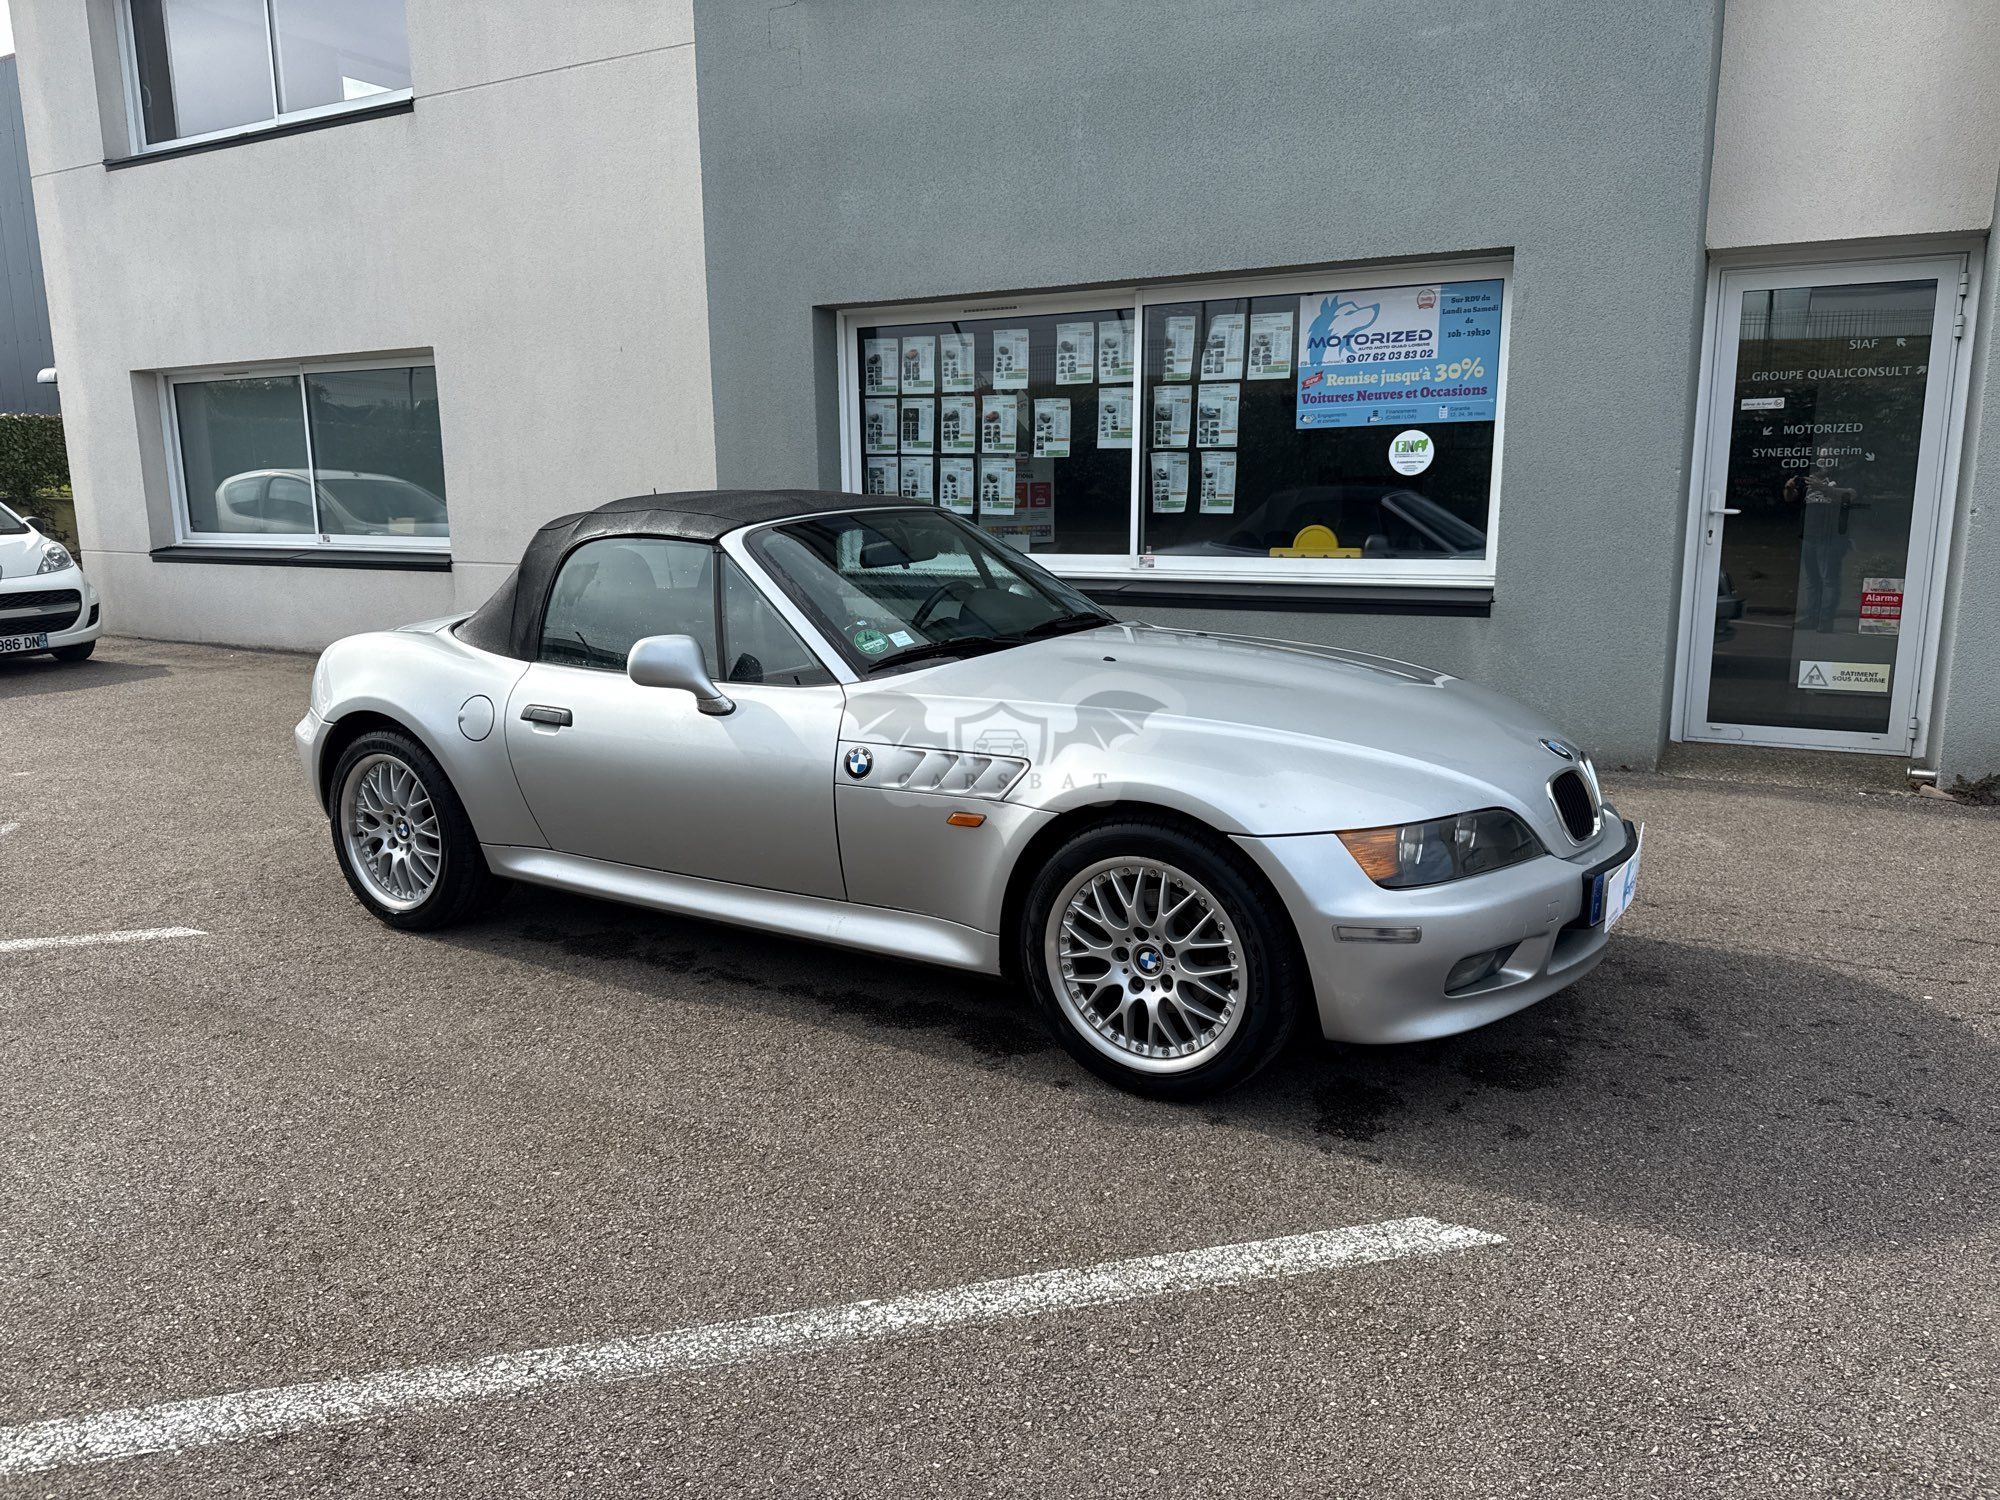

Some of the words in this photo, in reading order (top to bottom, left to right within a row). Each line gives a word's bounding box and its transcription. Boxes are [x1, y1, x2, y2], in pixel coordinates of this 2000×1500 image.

[1451, 296, 1463, 304] Sur
[1464, 295, 1480, 303] RDV
[1481, 294, 1491, 302] du
[1442, 305, 1462, 314] Lundi
[1472, 304, 1499, 313] Samedi
[1307, 329, 1433, 349] MOTORIZED
[1448, 329, 1462, 338] 10h
[1467, 328, 1491, 337] 19h30
[1849, 338, 1879, 350] SIAF
[1358, 354, 1371, 362] 07
[1373, 352, 1386, 361] 62
[1388, 352, 1402, 360] 03
[1404, 350, 1417, 359] 83
[1420, 349, 1434, 358] 02
[1326, 371, 1378, 386] Remise
[1380, 366, 1432, 387] jusqu'à
[1434, 356, 1485, 382] 30%
[1752, 370, 1804, 382] GROUPE
[1807, 365, 1912, 380] QUALICONSULT
[1302, 389, 1354, 405] Voitures
[1356, 387, 1403, 402] Neuves
[1405, 388, 1418, 400] et
[1420, 384, 1488, 400] Occasions
[1784, 422, 1864, 435] MOTORIZED
[1752, 447, 1812, 458] SYNERGIE
[1816, 446, 1862, 456] Interim
[1781, 458, 1839, 468] CDD-CDI
[1866, 594, 1899, 602] Alarme
